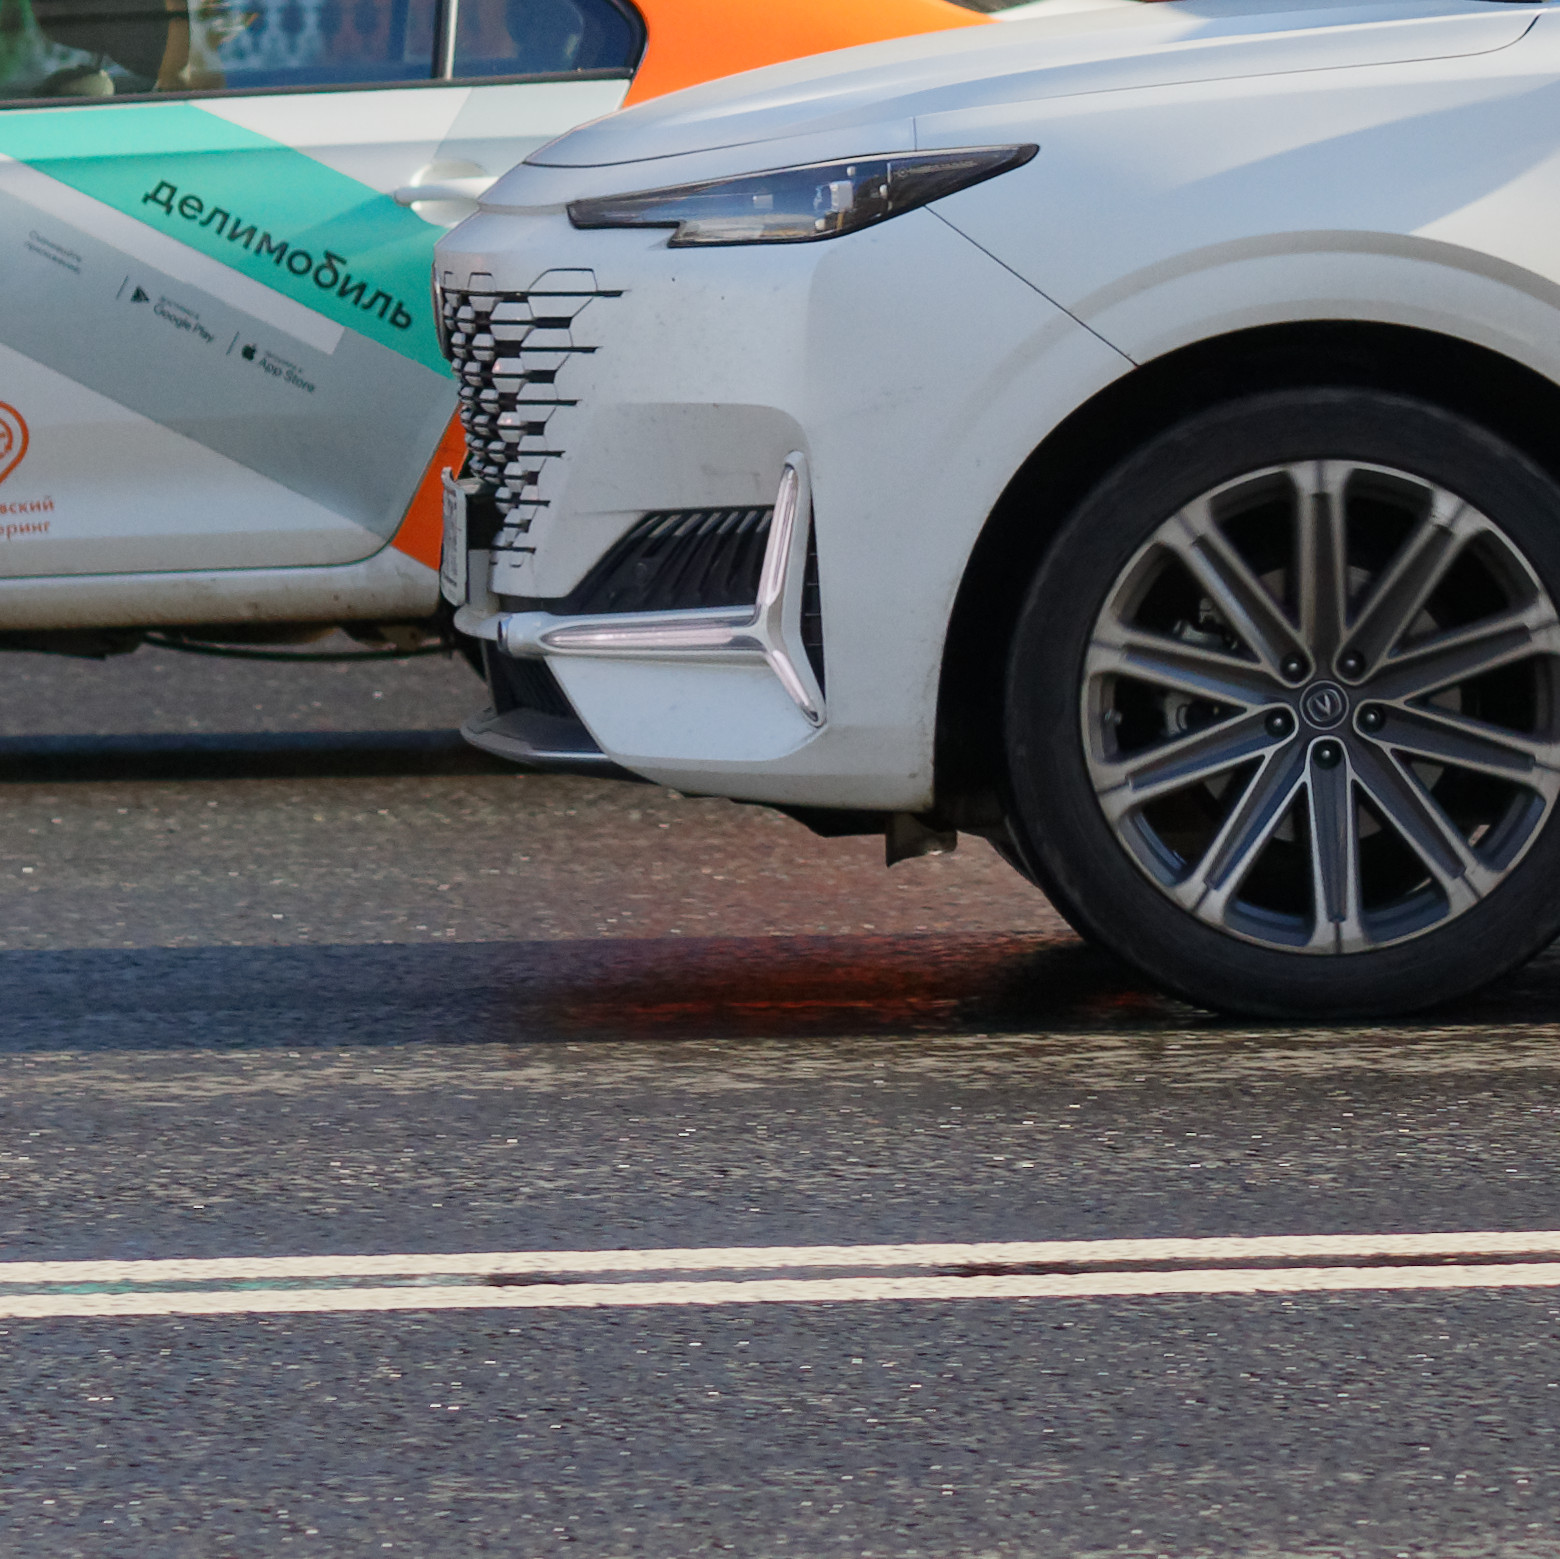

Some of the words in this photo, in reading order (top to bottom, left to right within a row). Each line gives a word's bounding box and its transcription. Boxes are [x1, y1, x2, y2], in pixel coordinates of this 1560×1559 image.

[142, 178, 414, 331] делимобиль
[153, 303, 192, 332] Google
[194, 322, 215, 344] Play
[258, 357, 283, 379] App
[284, 365, 317, 394] Store
